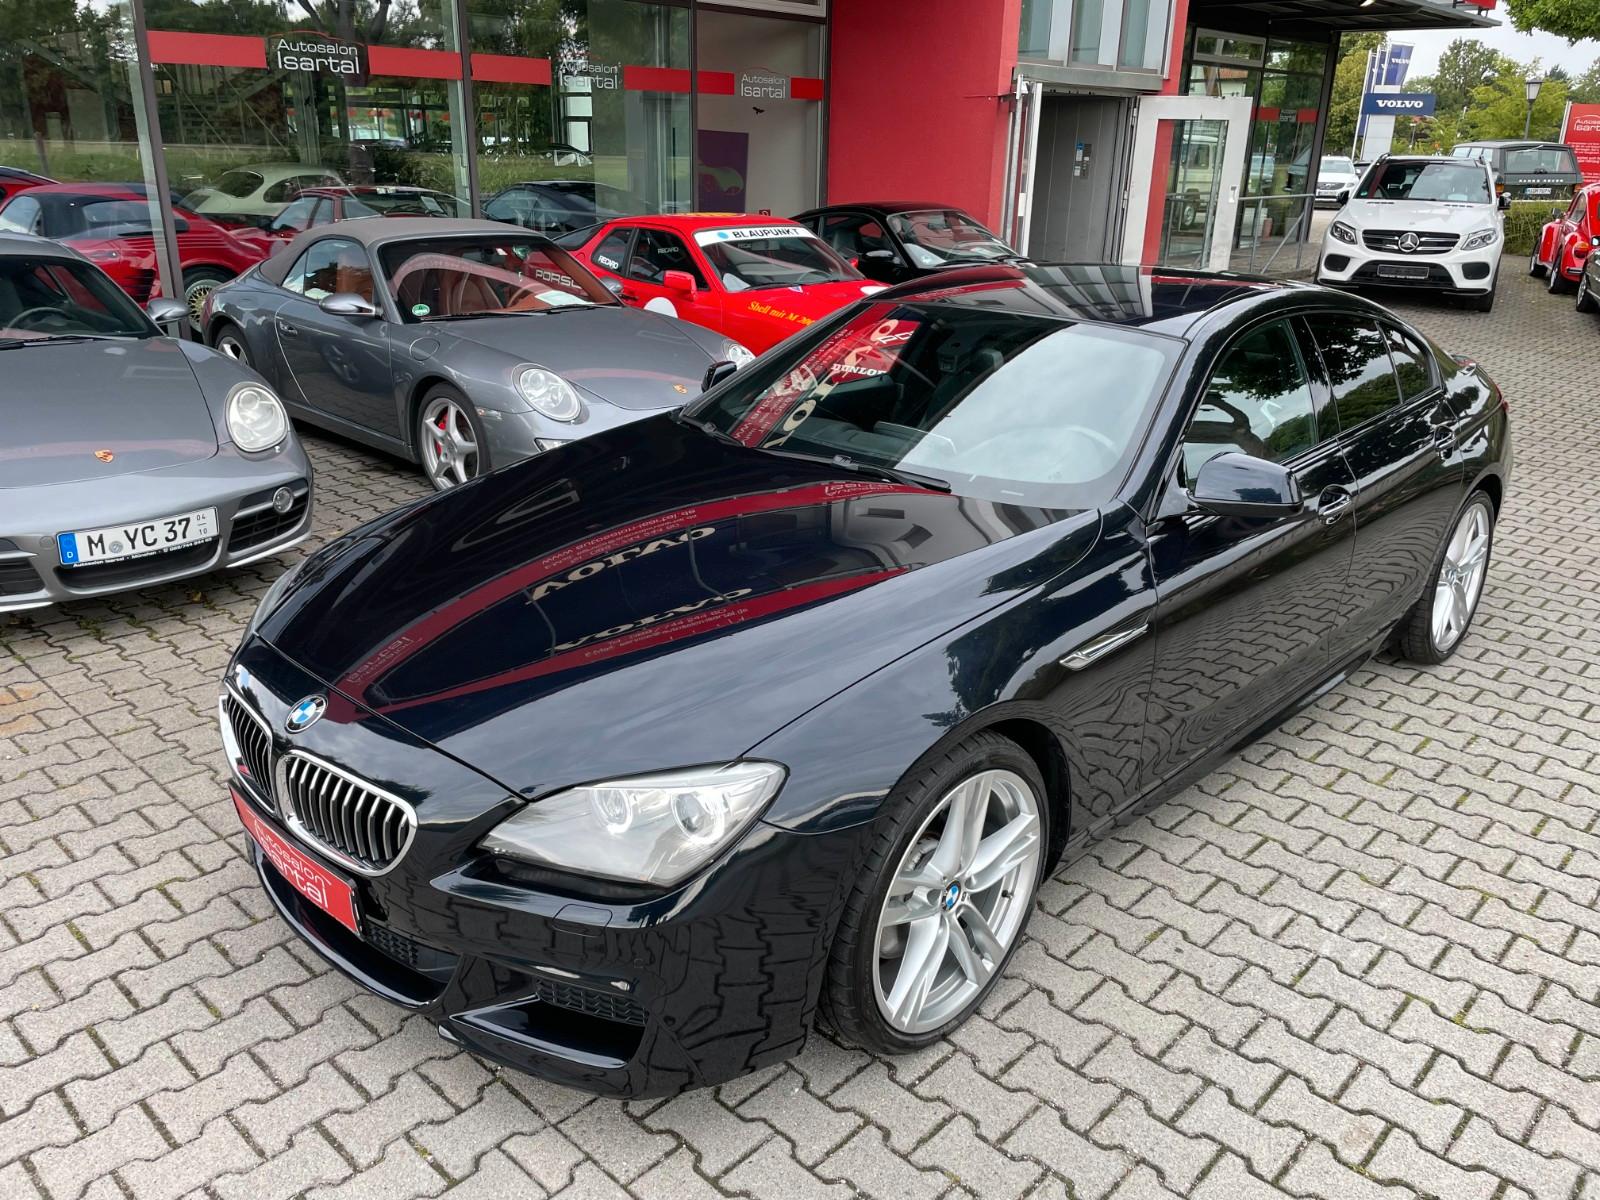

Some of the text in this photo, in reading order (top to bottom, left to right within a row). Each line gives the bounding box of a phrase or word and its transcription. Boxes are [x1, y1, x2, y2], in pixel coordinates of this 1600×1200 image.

[277, 38, 358, 55] Autosalon
[277, 51, 360, 74] Isartal
[560, 58, 618, 74] Autosalon
[559, 71, 618, 89] Isartal
[741, 73, 786, 85] Autosalon
[741, 82, 786, 99] Isartal
[1376, 99, 1424, 109] VOLVO
[732, 228, 800, 239] BLAUPUNKT
[658, 246, 679, 255] RECARO
[597, 254, 619, 271] RECARO
[748, 301, 771, 315] Shell
[196, 513, 206, 521] 04
[87, 517, 191, 556] M YC 37
[255, 822, 326, 885] Autosalon
[255, 827, 329, 910] Isartal
